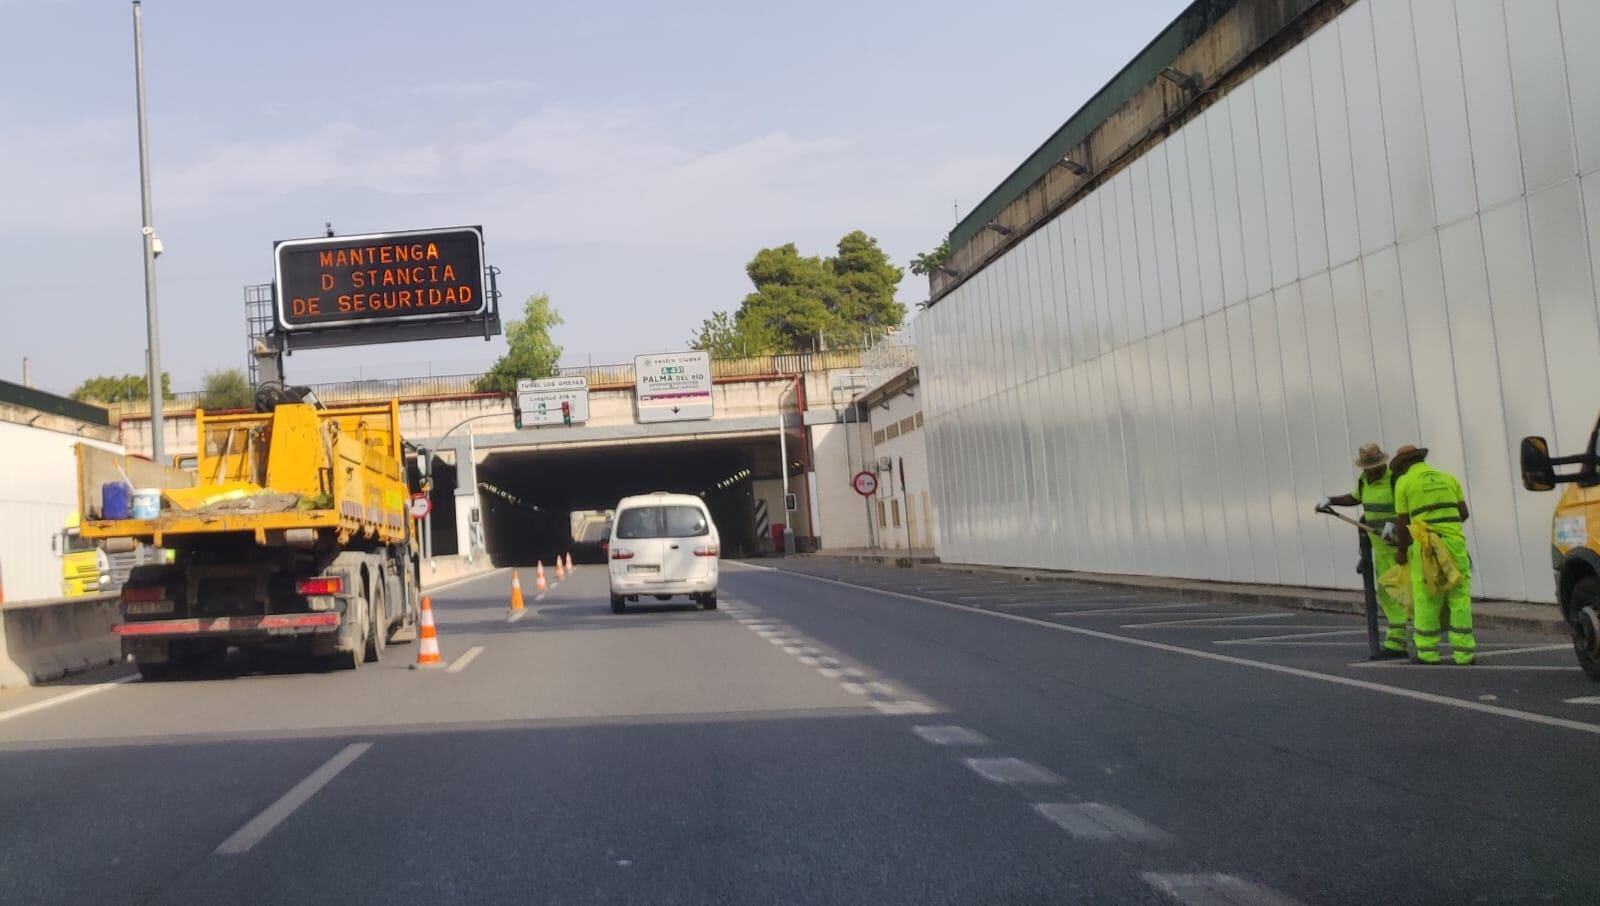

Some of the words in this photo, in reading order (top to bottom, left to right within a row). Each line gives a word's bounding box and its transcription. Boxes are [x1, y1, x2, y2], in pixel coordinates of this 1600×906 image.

[319, 242, 439, 268] MANTENGA
[351, 264, 456, 289] STANCIA
[291, 297, 322, 317] DE
[337, 285, 473, 312] SEGURIDAD
[642, 375, 673, 383] PALMA
